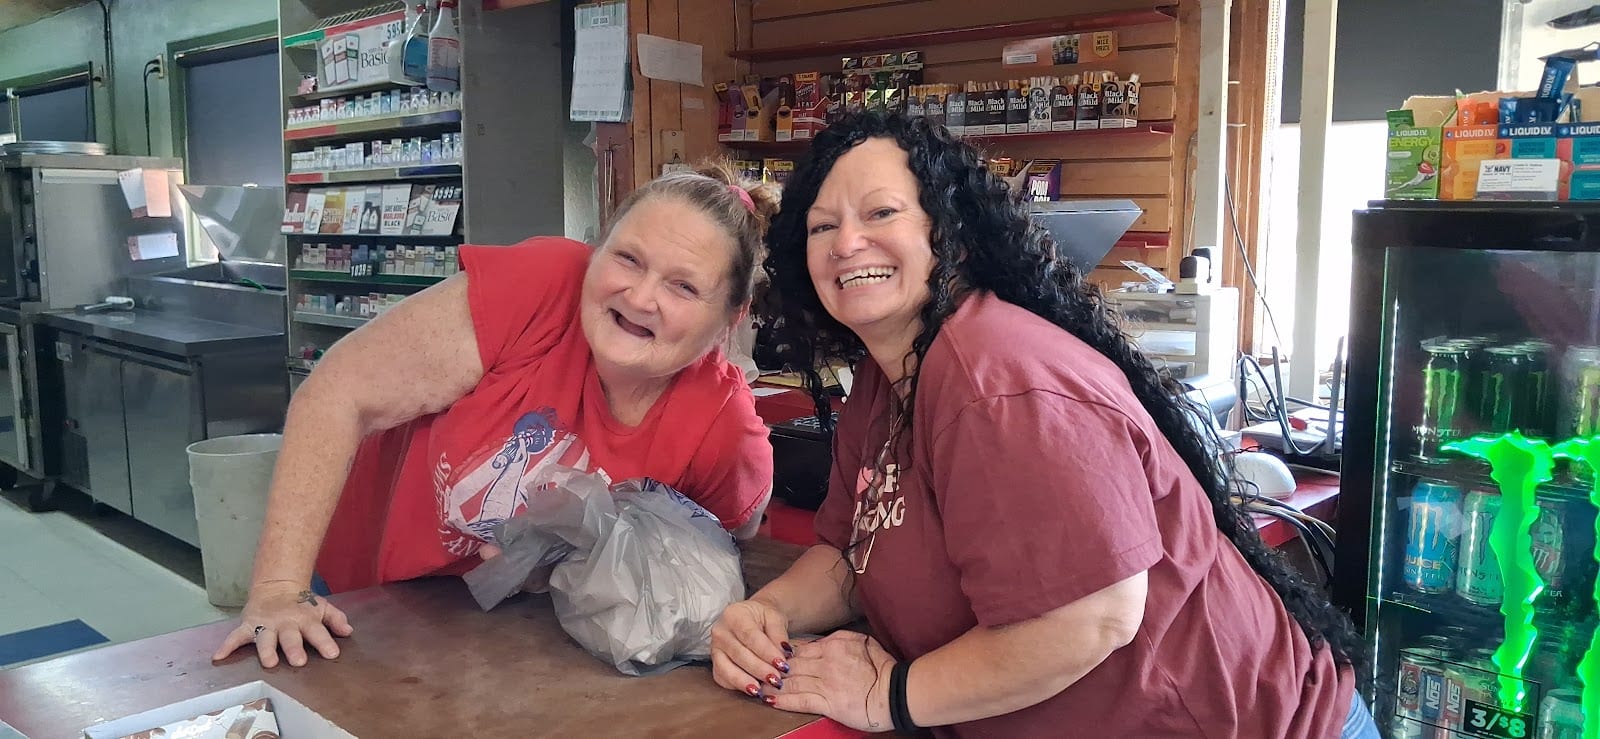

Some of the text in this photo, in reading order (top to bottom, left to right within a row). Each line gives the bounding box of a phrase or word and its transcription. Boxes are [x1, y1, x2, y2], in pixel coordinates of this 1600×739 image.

[1396, 129, 1419, 137] LIQUID
[1455, 130, 1485, 138] LIQUID
[1509, 127, 1540, 136] LIQUID
[1391, 137, 1435, 147] ENERGY
[1493, 165, 1512, 173] NAVY
[1425, 675, 1441, 710] NOS
[1446, 679, 1460, 713] NOS
